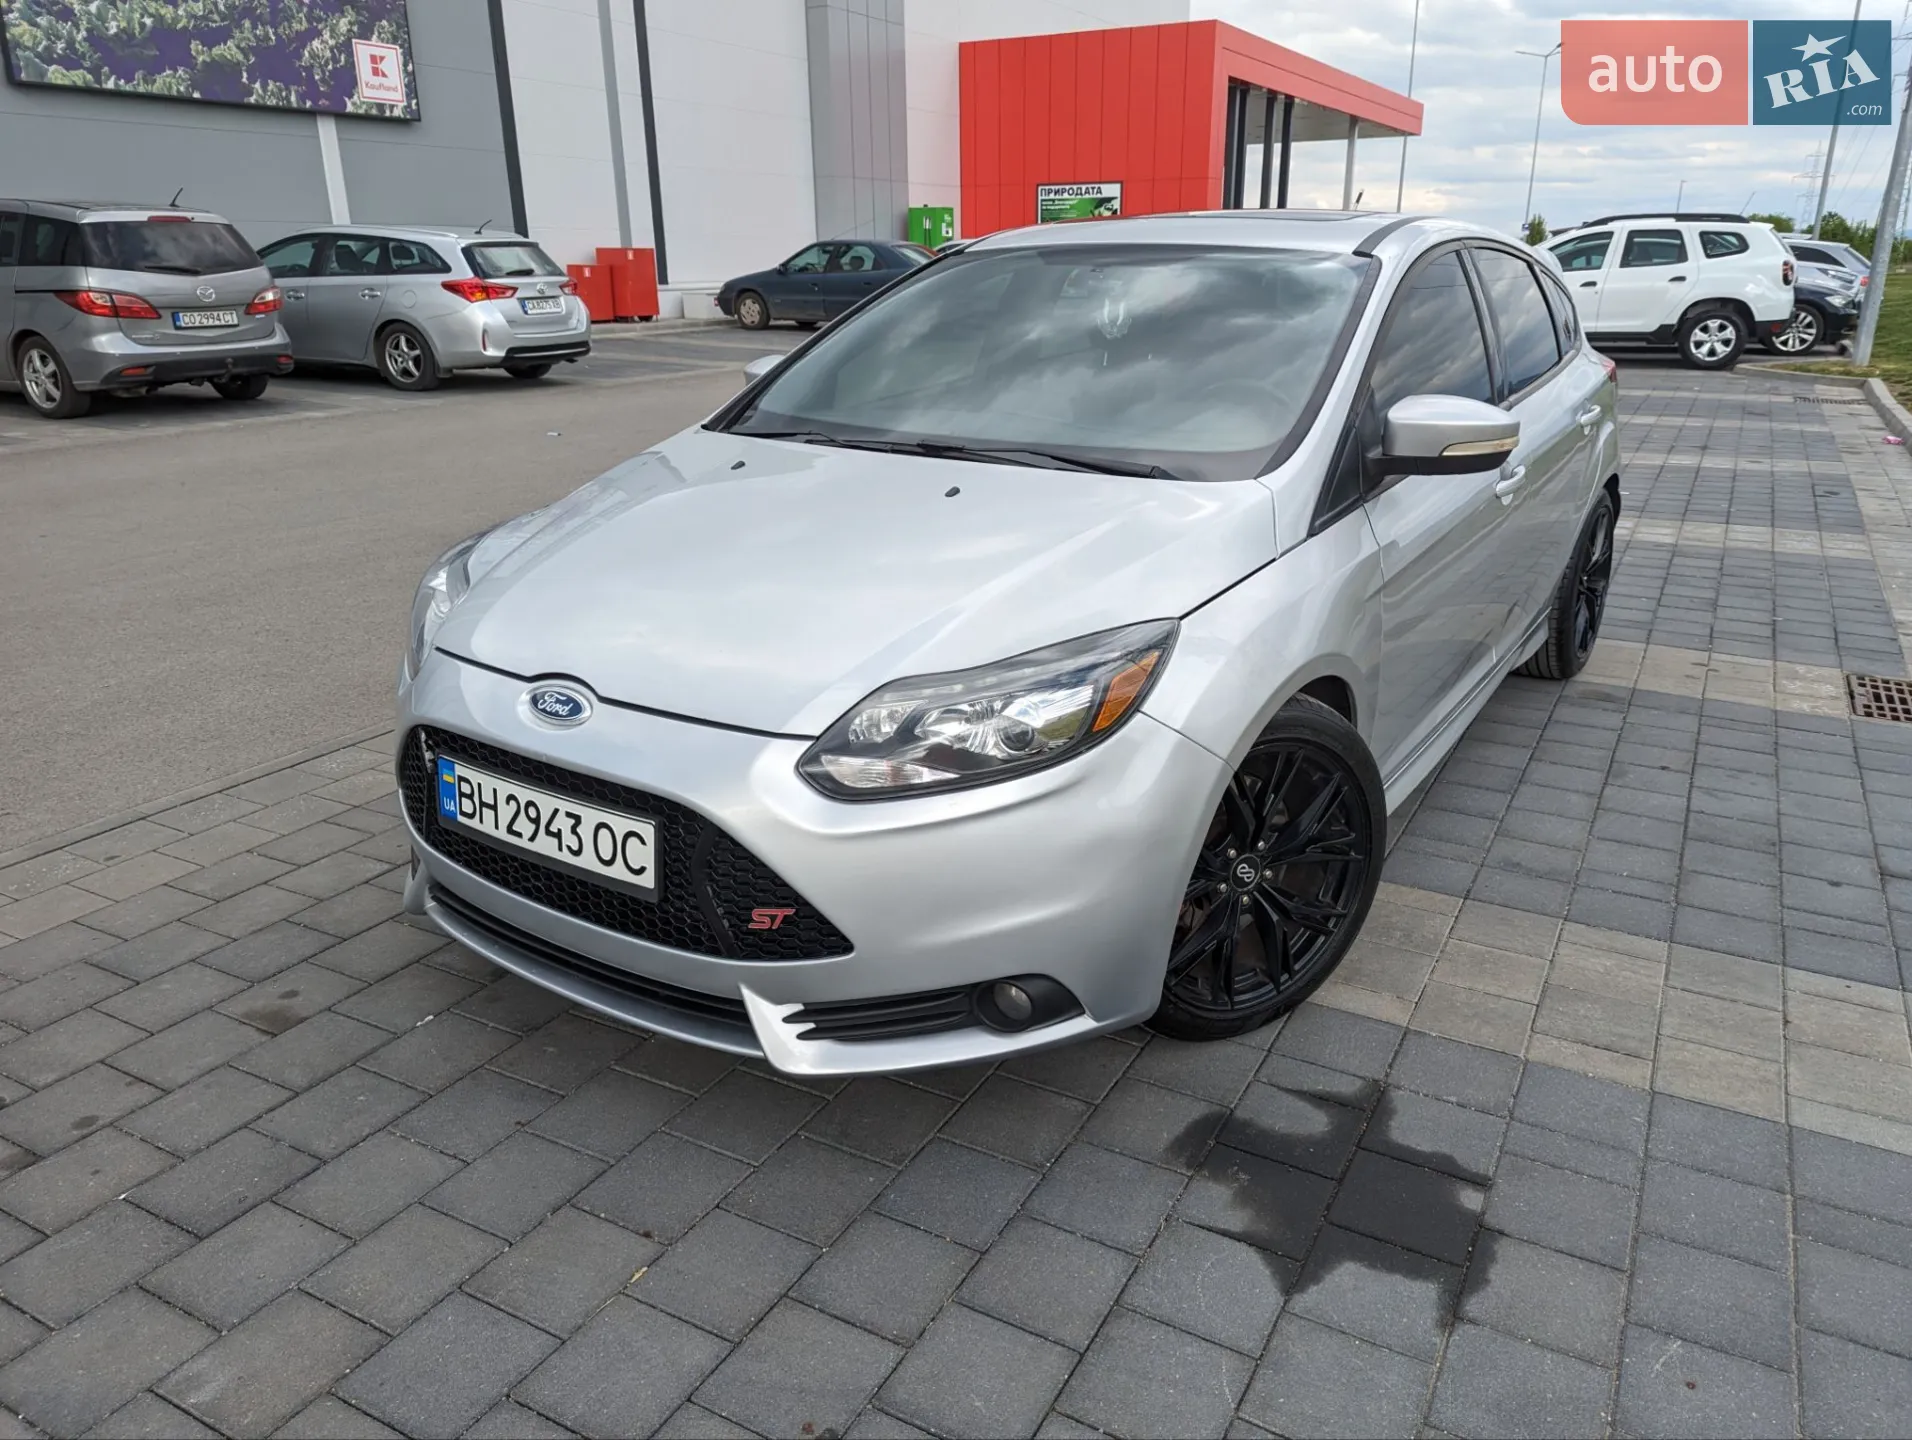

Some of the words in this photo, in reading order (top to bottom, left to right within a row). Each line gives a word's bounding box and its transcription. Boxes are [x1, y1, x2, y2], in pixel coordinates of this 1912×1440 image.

[364, 80, 399, 93] Kaufland
[1040, 186, 1103, 197] ПРИРОДАТА
[199, 313, 221, 325] 2994
[537, 691, 574, 716] Ford
[443, 797, 456, 813] UA
[457, 774, 499, 830] BH
[505, 793, 583, 857] 2943
[593, 821, 648, 876] OC
[748, 908, 797, 930] ST
